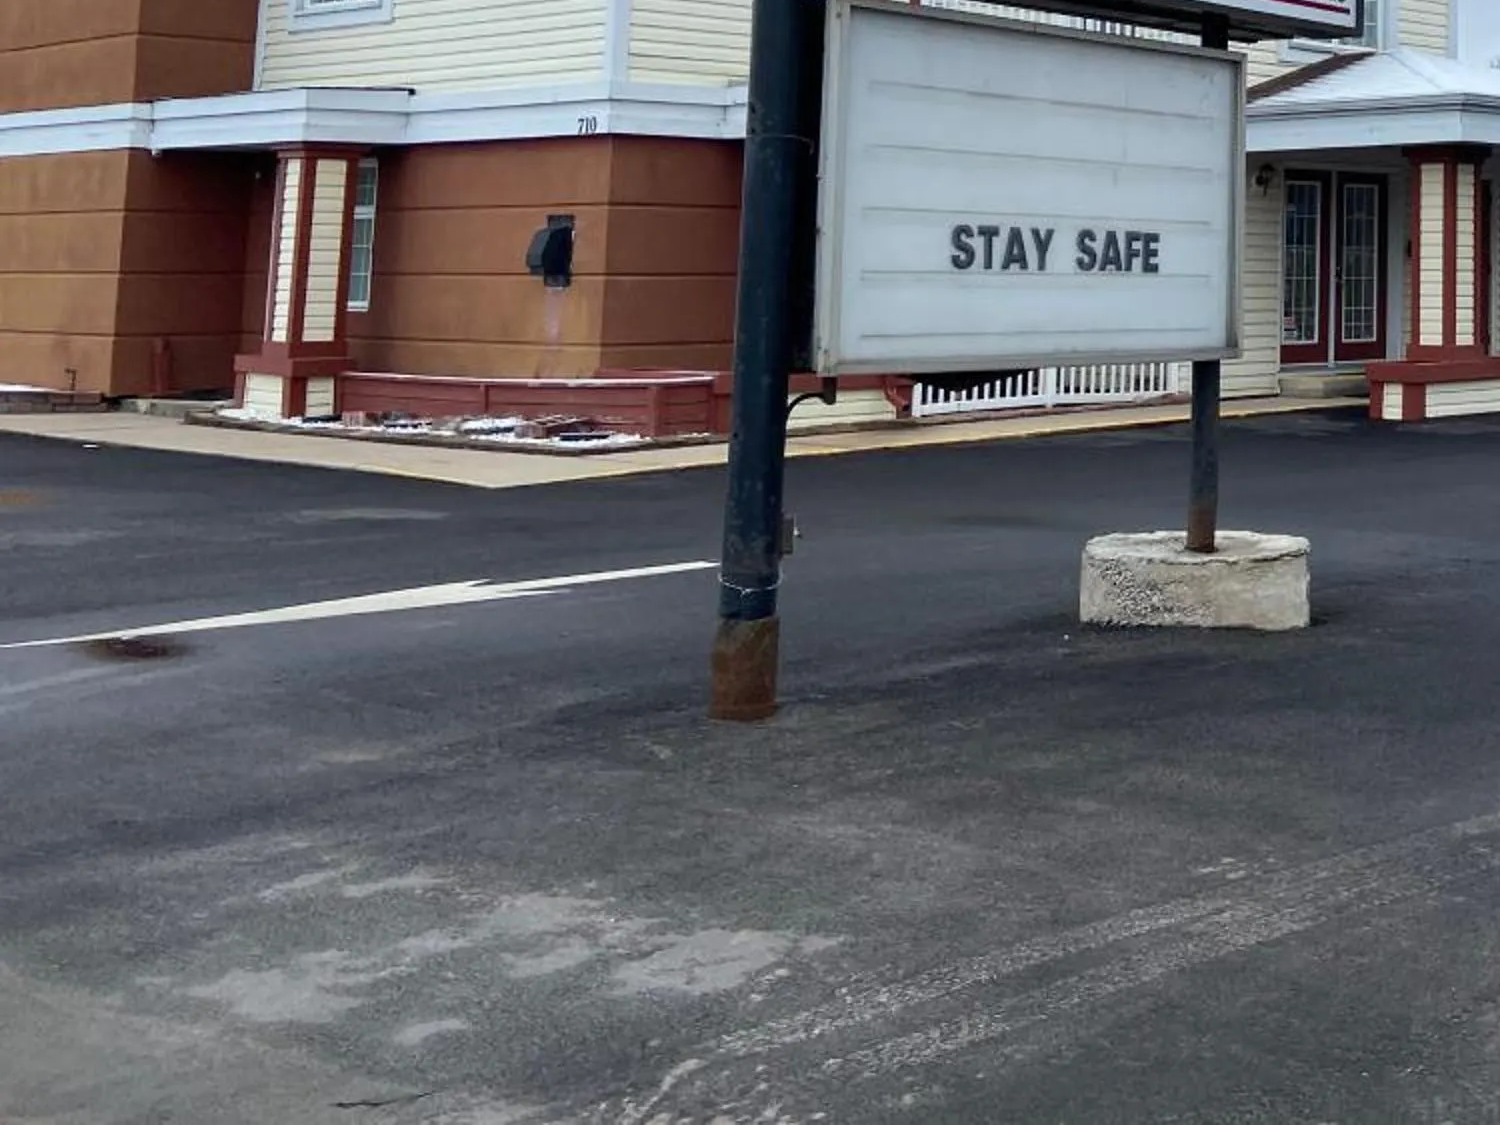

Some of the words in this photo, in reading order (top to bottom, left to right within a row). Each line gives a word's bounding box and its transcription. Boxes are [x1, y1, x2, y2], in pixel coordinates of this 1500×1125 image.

[577, 116, 597, 134] 710
[950, 224, 1056, 271] STAY
[1076, 229, 1160, 274] SAFE
